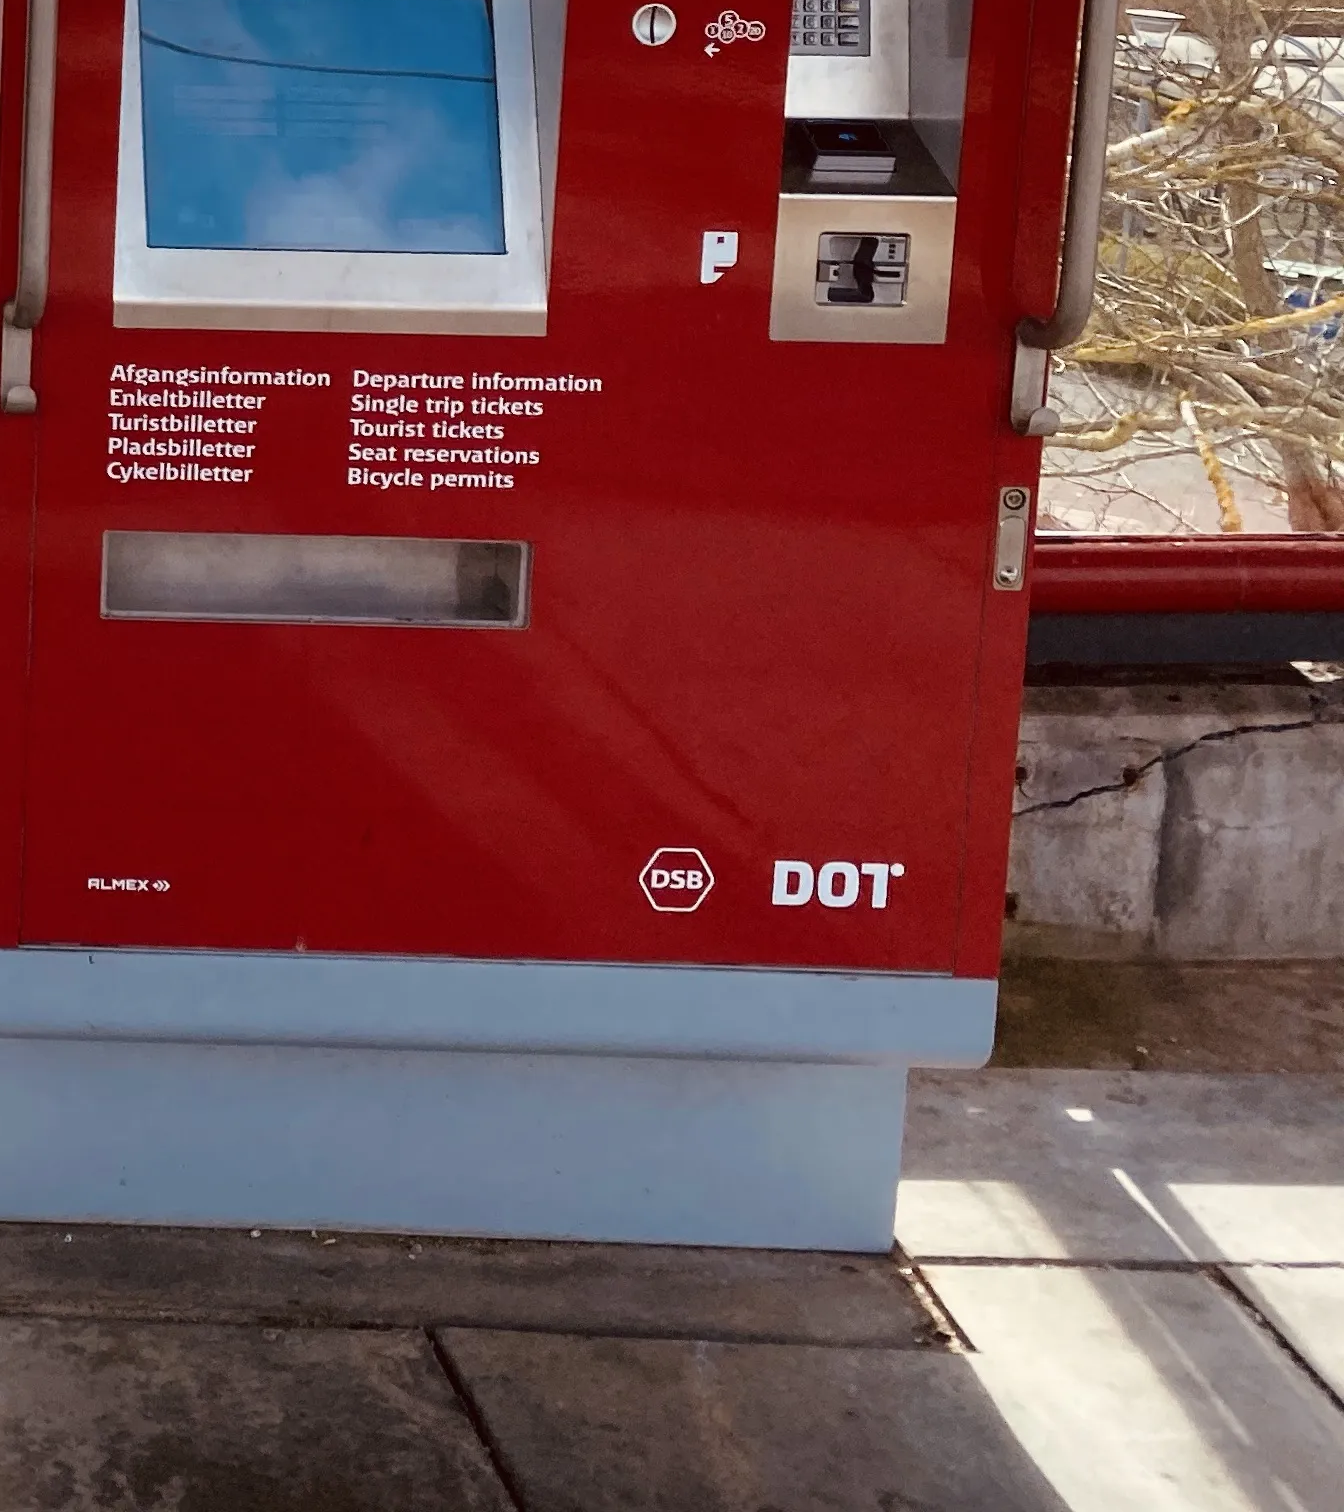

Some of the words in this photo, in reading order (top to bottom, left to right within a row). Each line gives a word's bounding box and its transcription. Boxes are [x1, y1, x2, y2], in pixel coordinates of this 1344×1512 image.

[110, 364, 331, 387] Afgangsinformation
[353, 369, 465, 392] Departure
[471, 372, 603, 393] information
[109, 388, 267, 410] Enkeltbilletter
[351, 394, 419, 416] Single
[425, 396, 464, 418] trip
[471, 397, 544, 416] tickets
[108, 413, 257, 434] Turistbilletter
[350, 419, 426, 438] Tourist
[432, 421, 505, 439] tickets
[108, 437, 256, 459] Pladsbilletter
[348, 443, 397, 462] Seat
[403, 446, 540, 465] reservations
[106, 461, 254, 483] Cykelbilletter
[347, 467, 424, 490] Bicycle
[430, 470, 515, 491] permits
[87, 877, 150, 892] ALMEX
[650, 869, 703, 890] DSB
[771, 859, 906, 909] DOT
